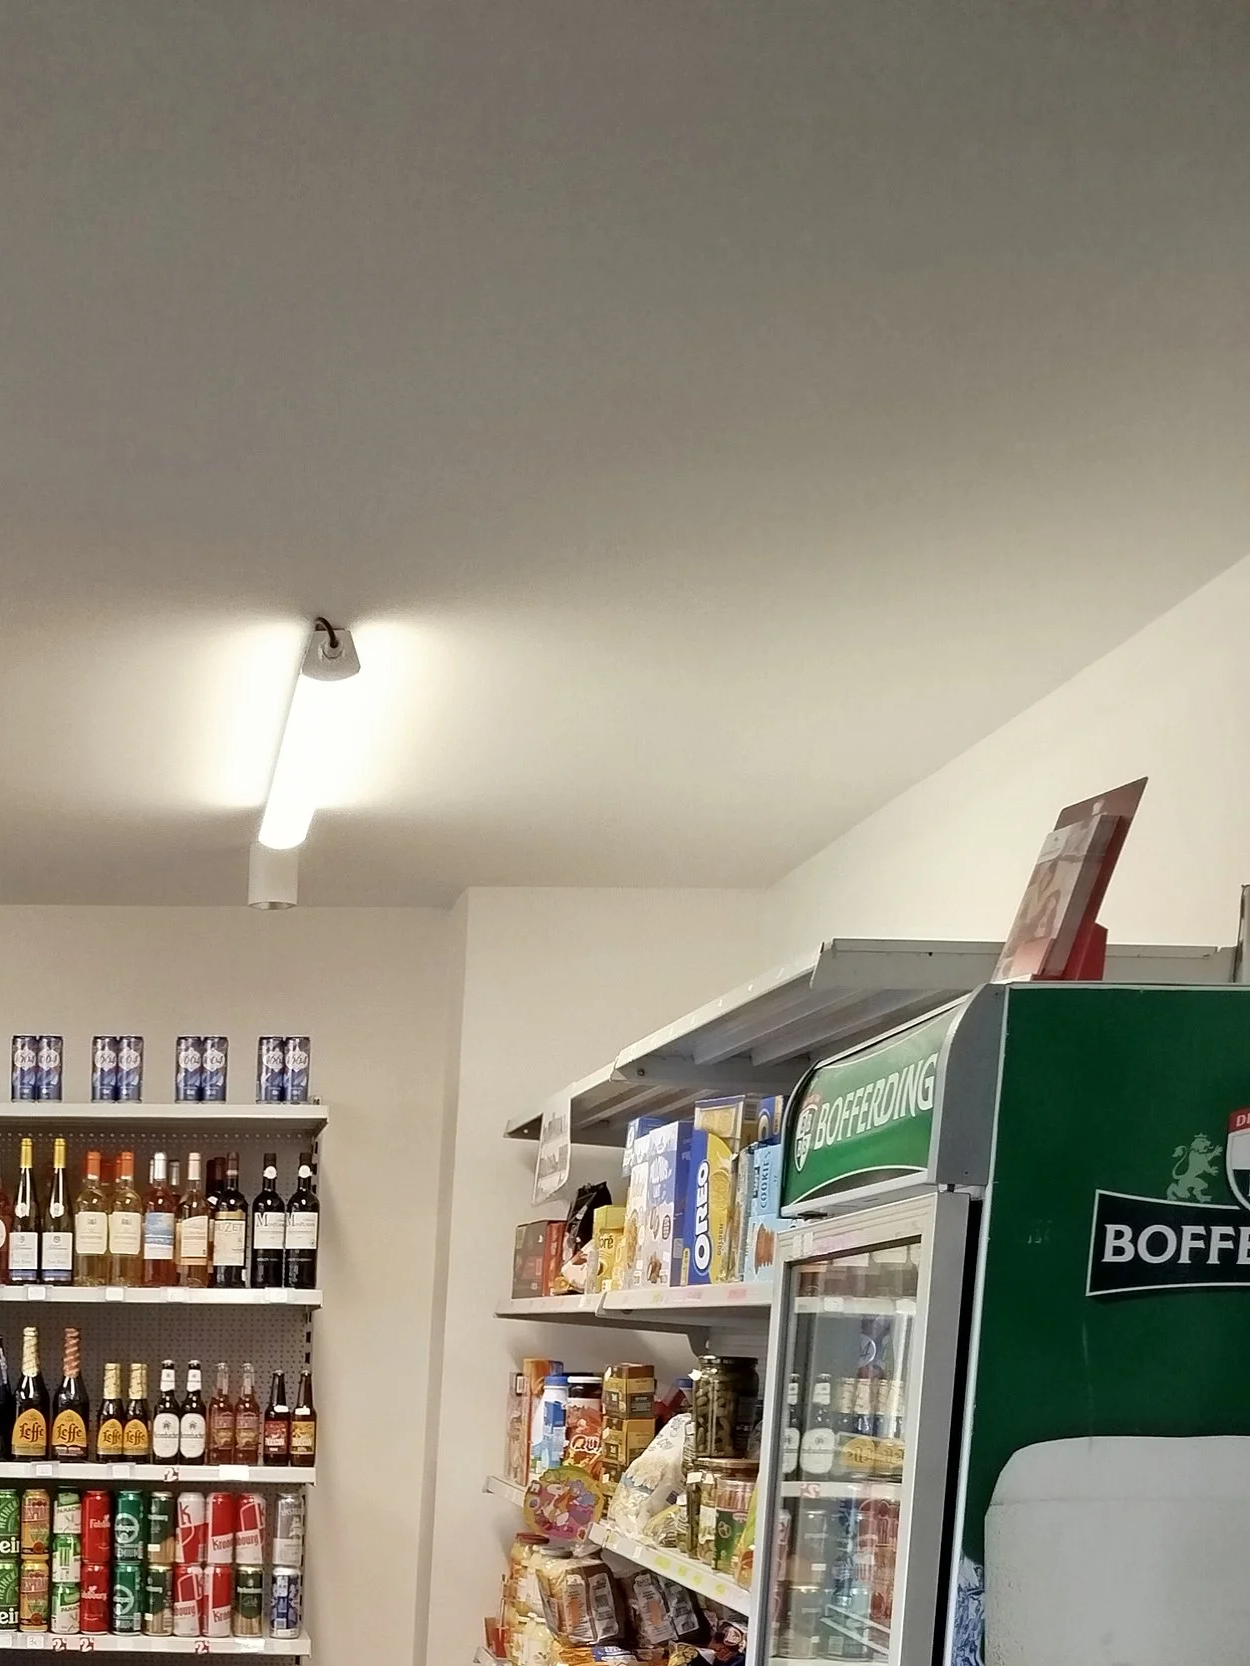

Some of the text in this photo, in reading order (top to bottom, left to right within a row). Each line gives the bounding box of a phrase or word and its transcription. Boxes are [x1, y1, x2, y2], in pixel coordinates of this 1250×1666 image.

[813, 1053, 939, 1151] BOFFERDING
[694, 1159, 711, 1272] OREO
[19, 1422, 44, 1443] Leffe
[57, 1422, 82, 1443] Leffe
[102, 1428, 122, 1445] Leffe
[125, 1428, 146, 1445] Leffe
